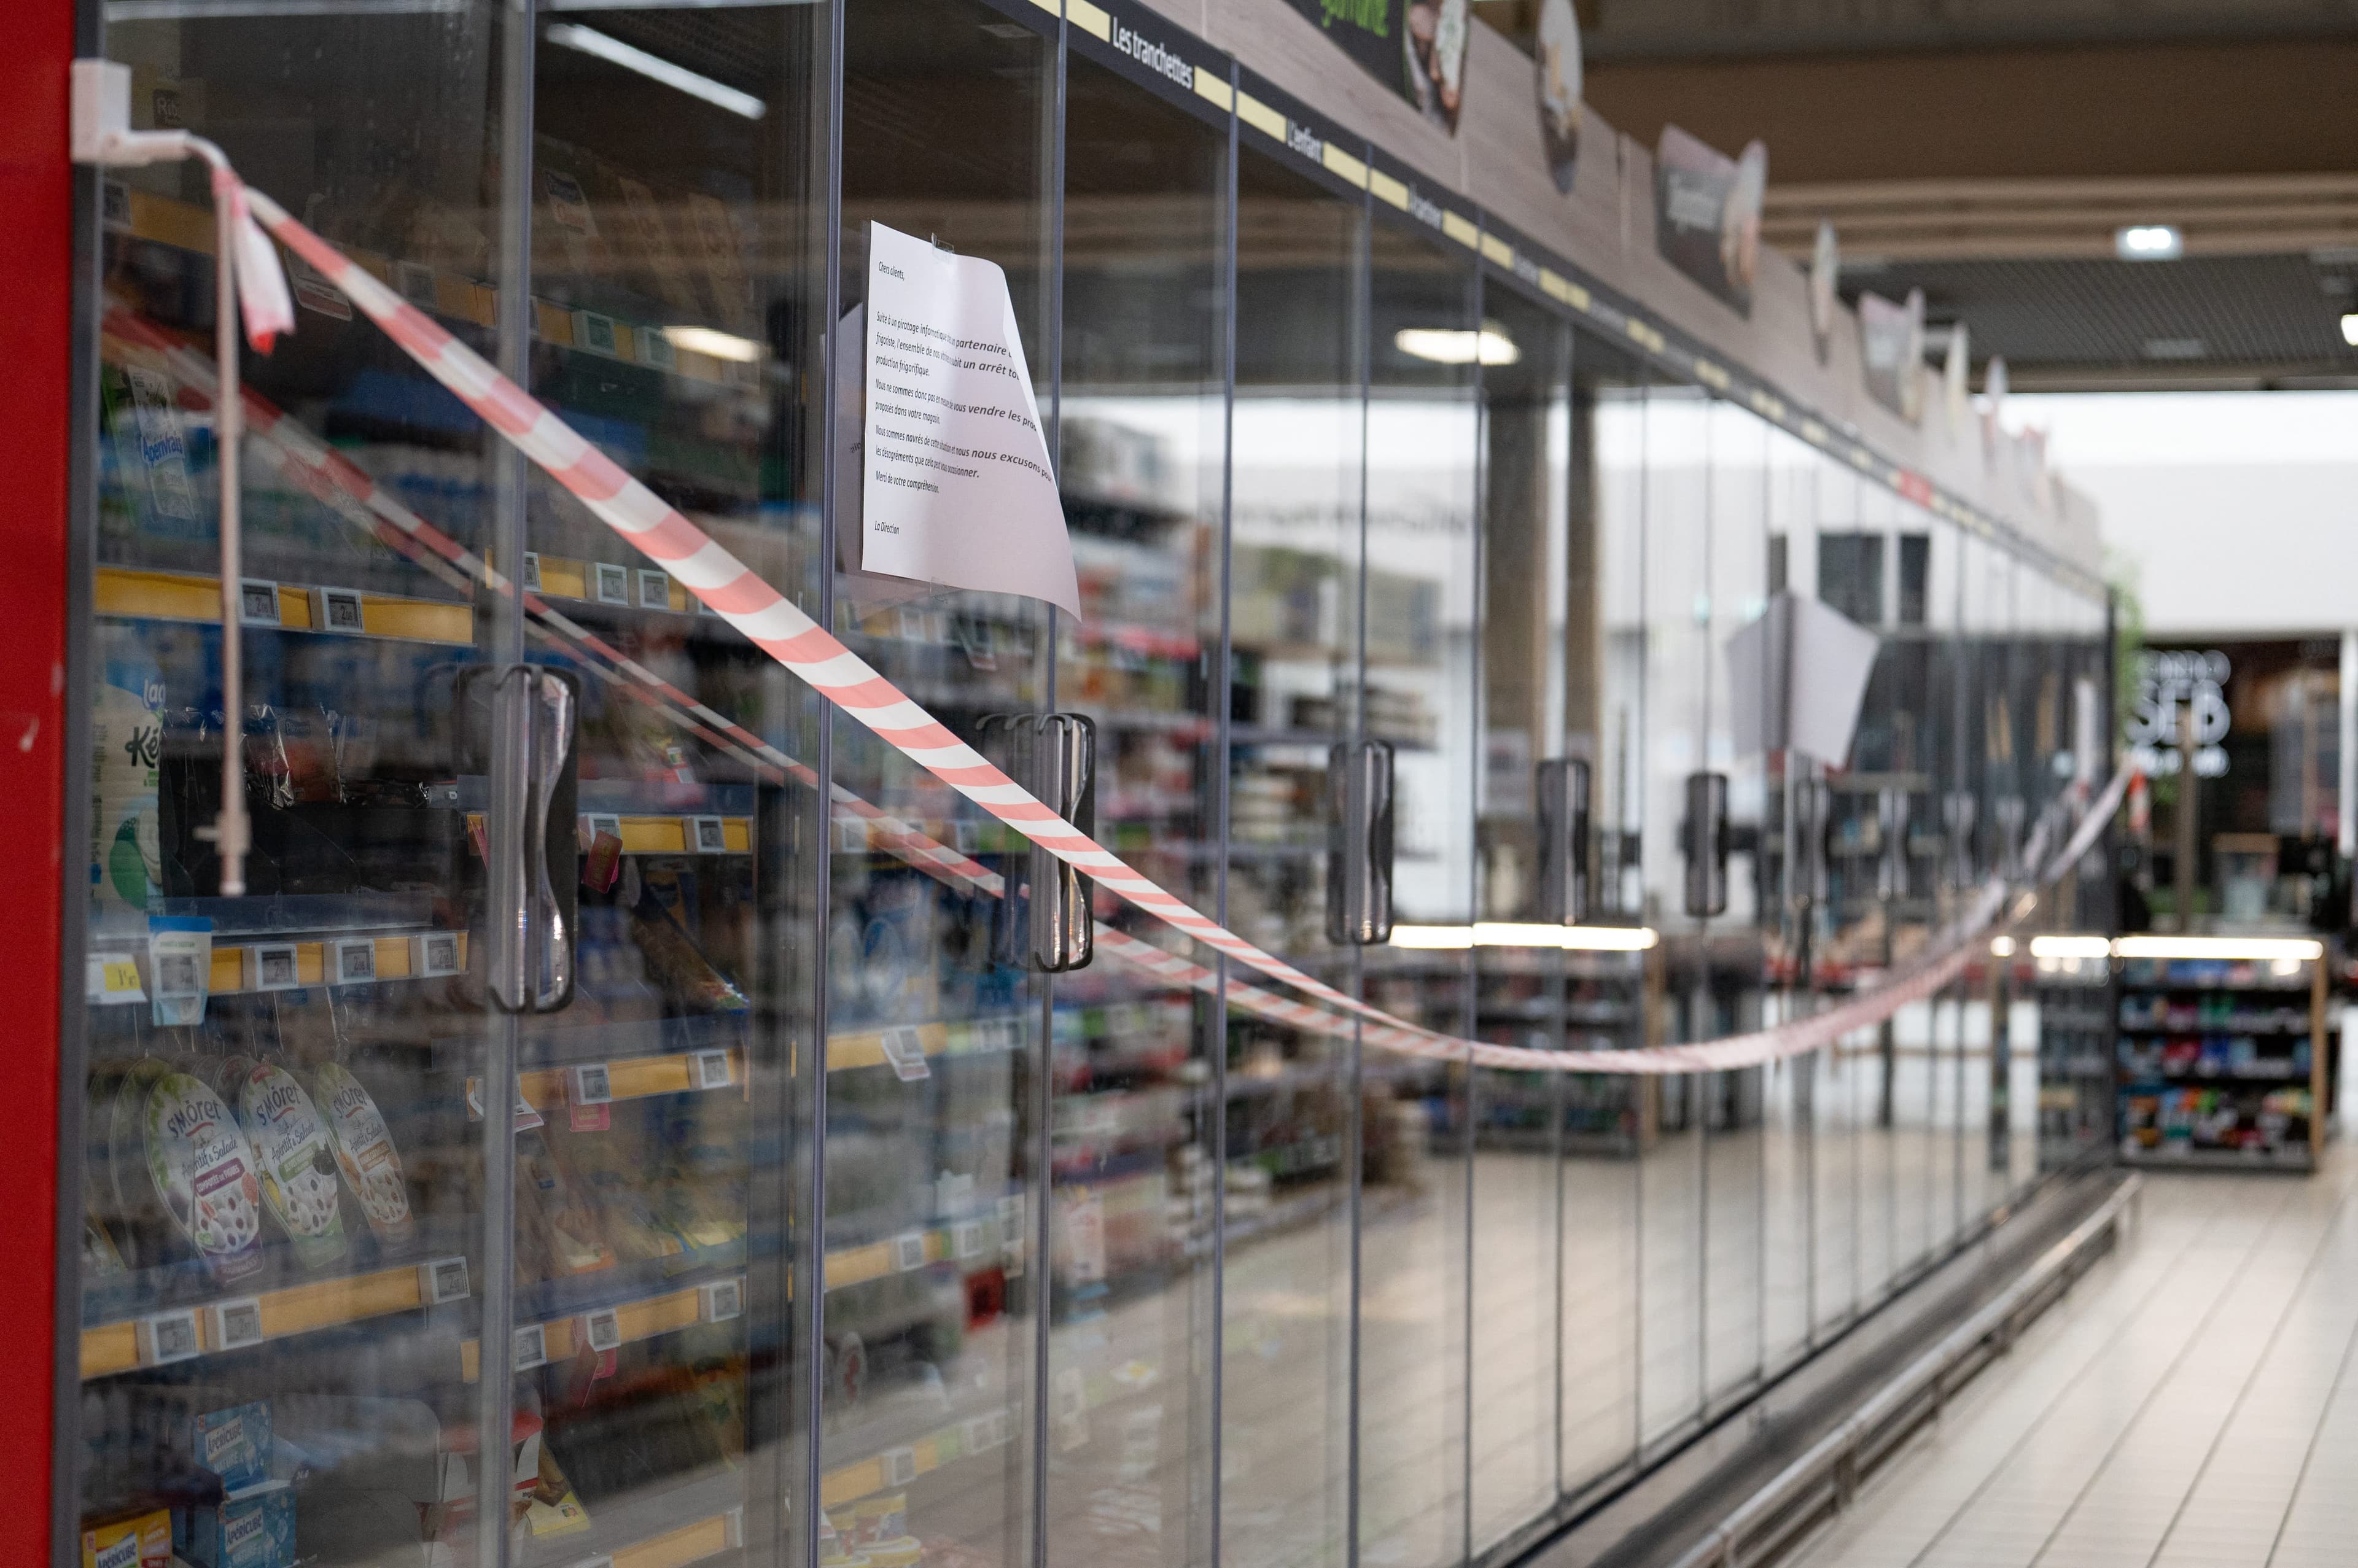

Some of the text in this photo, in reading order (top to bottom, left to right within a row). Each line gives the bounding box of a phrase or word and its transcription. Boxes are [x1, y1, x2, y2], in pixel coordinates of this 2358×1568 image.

[1112, 16, 1193, 90] Les tranchettes
[879, 261, 905, 281] Chers clients,
[876, 311, 887, 324] Suite
[887, 314, 891, 325] à
[897, 319, 919, 335] piratage
[955, 339, 1007, 355] partenaire
[876, 332, 896, 349] frigoriste,
[897, 338, 925, 355] l'ensemble
[925, 345, 933, 356] de
[963, 360, 976, 370] un
[979, 363, 1006, 375] arrêt
[876, 354, 930, 377] production frigorifique.
[875, 378, 885, 391] Nous
[886, 384, 892, 393] ne
[892, 386, 914, 397] sommes
[914, 388, 927, 400] donc
[953, 403, 967, 413] vous
[968, 405, 1006, 418] vendre
[1008, 409, 1021, 422] les
[875, 401, 893, 414] proposés
[894, 404, 907, 417] dans
[908, 409, 922, 419] votre
[876, 424, 885, 437] Nous
[886, 429, 905, 441] sommes
[906, 433, 924, 445] navrés
[924, 435, 930, 446] de
[955, 447, 970, 457] nous
[971, 449, 998, 460] nous
[1000, 453, 1041, 473] excusons
[882, 446, 914, 464] désagréments
[914, 456, 924, 467] que
[925, 456, 933, 467] cela
[947, 465, 980, 478] occasionner.
[875, 470, 887, 483] Merci
[887, 473, 893, 484] de
[893, 476, 906, 487] votre
[874, 520, 900, 535] La Direction
[295, 1119, 316, 1144] Salade
[212, 1135, 238, 1161] Salade
